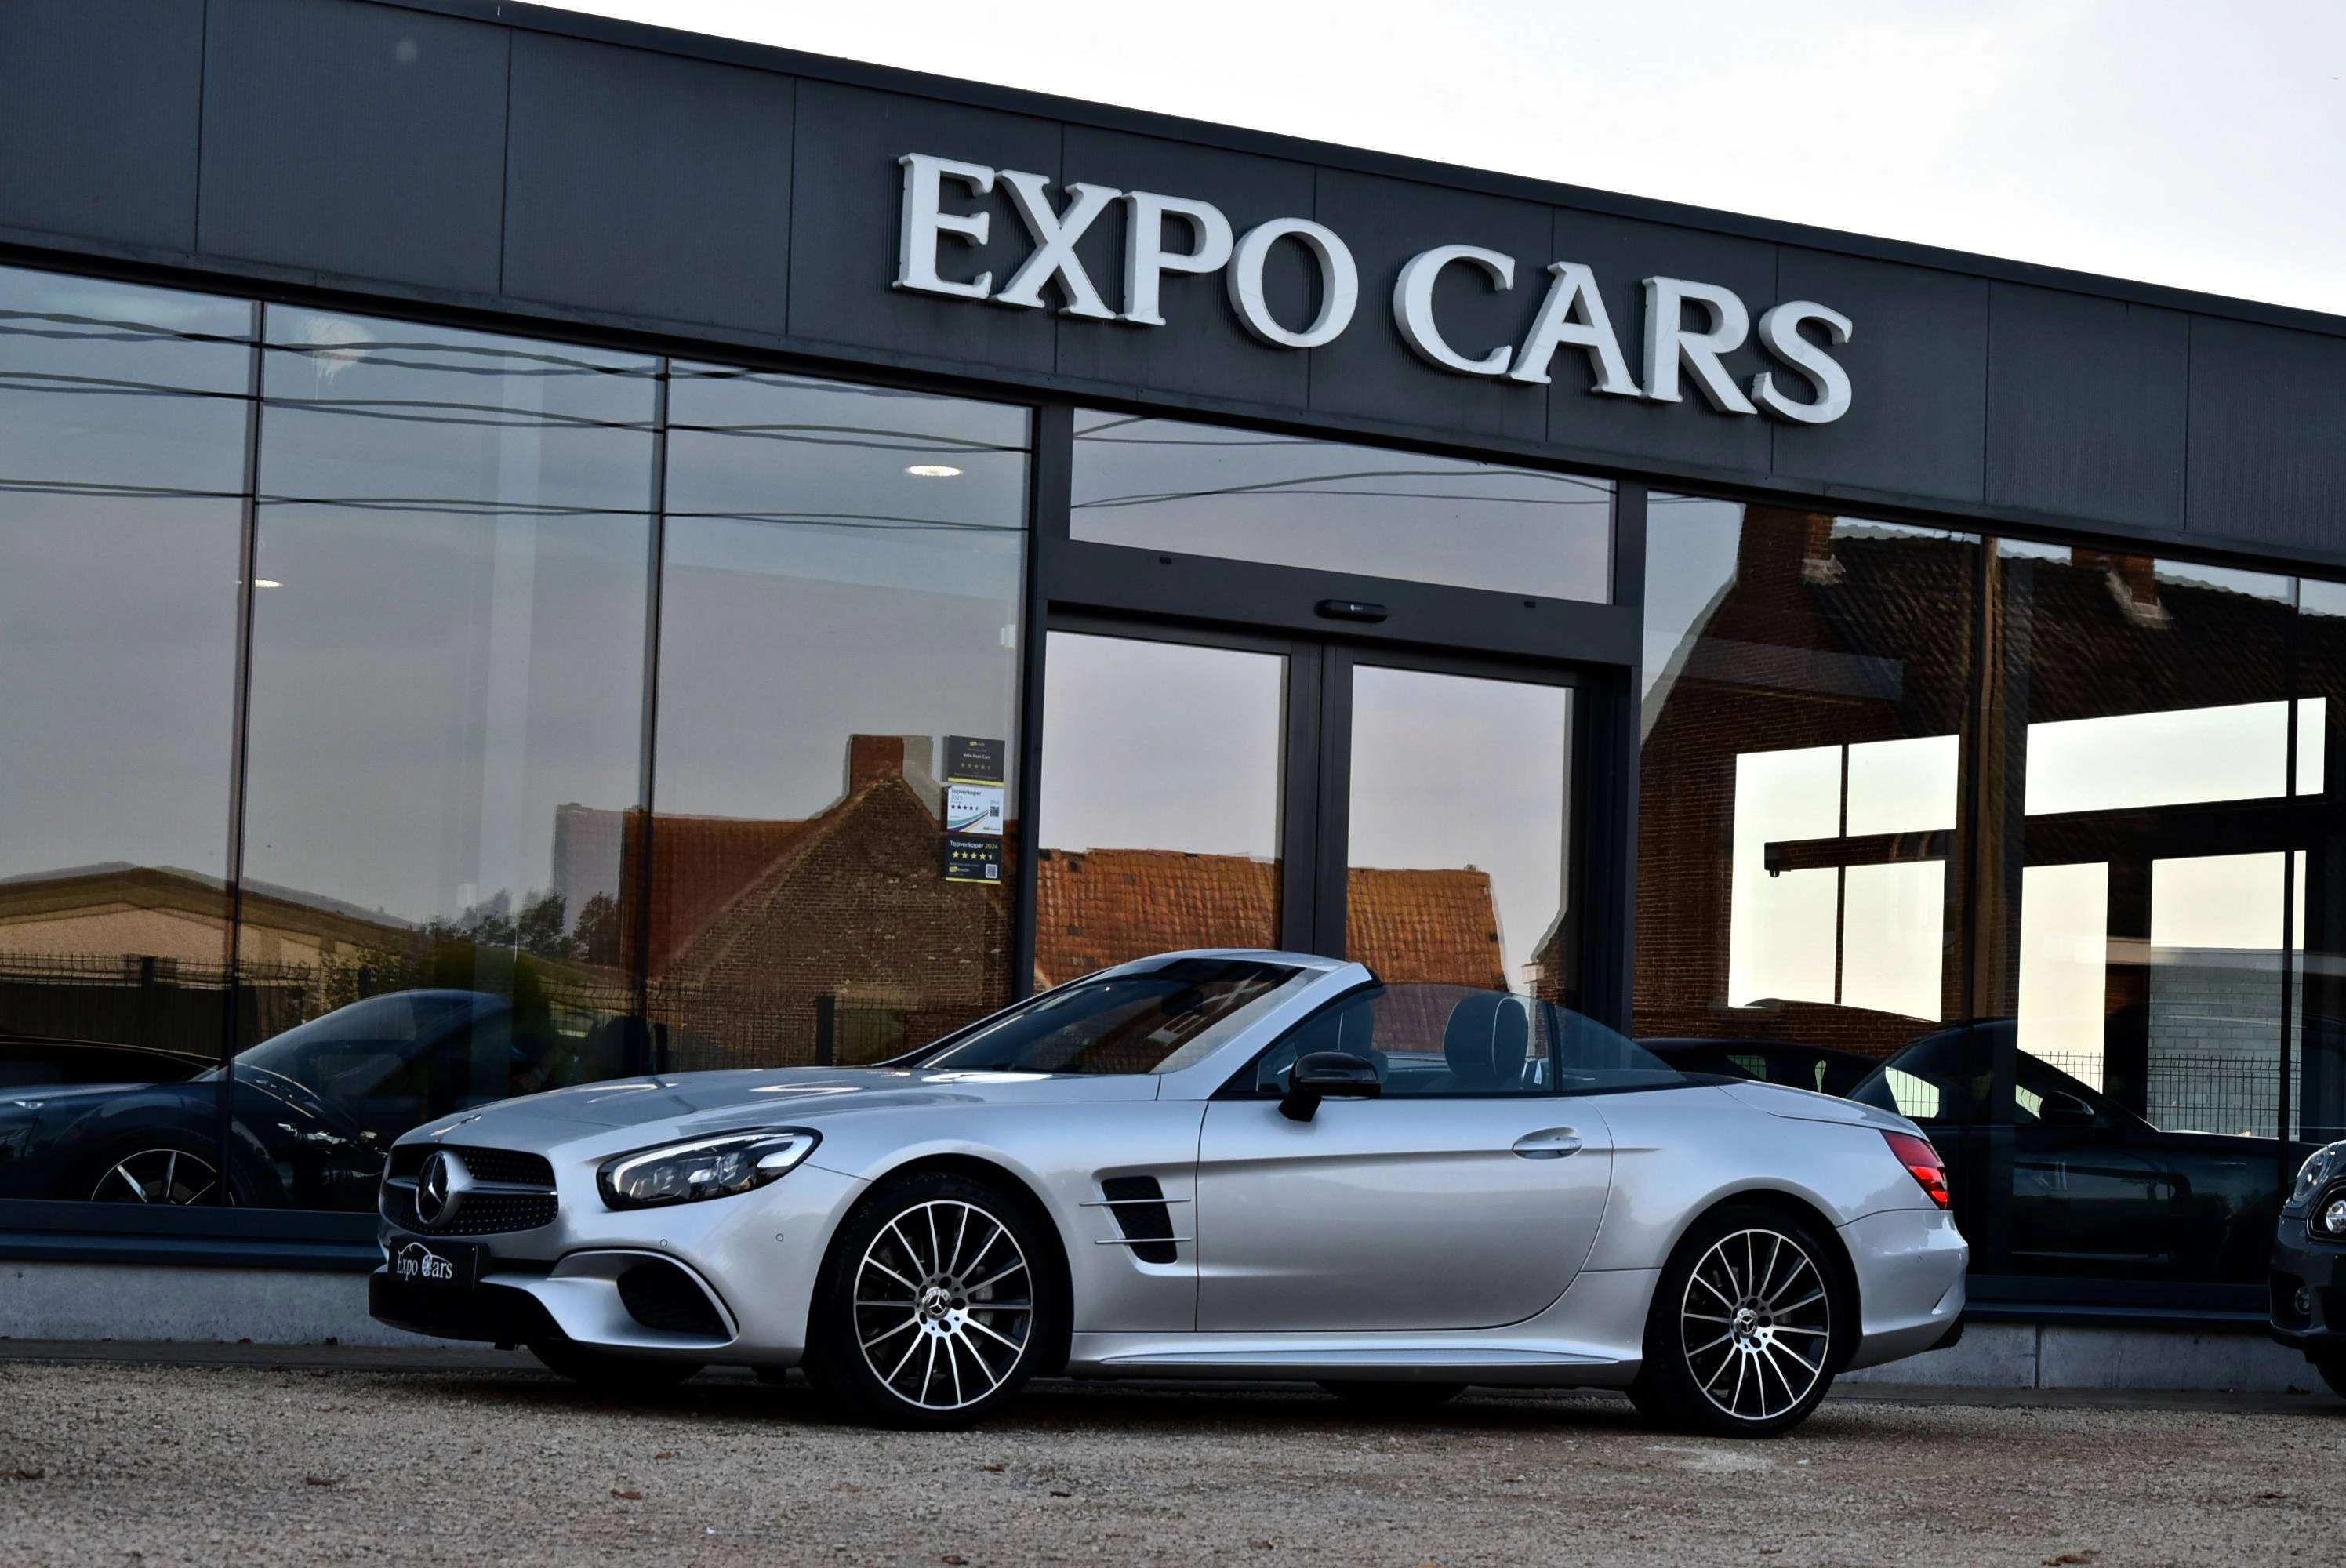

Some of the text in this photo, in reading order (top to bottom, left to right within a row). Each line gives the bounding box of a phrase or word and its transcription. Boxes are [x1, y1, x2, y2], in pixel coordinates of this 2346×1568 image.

[892, 153, 1853, 423] EXPO CARS
[950, 840, 984, 849] Topverkoper
[397, 1250, 453, 1282] Expo Cars
